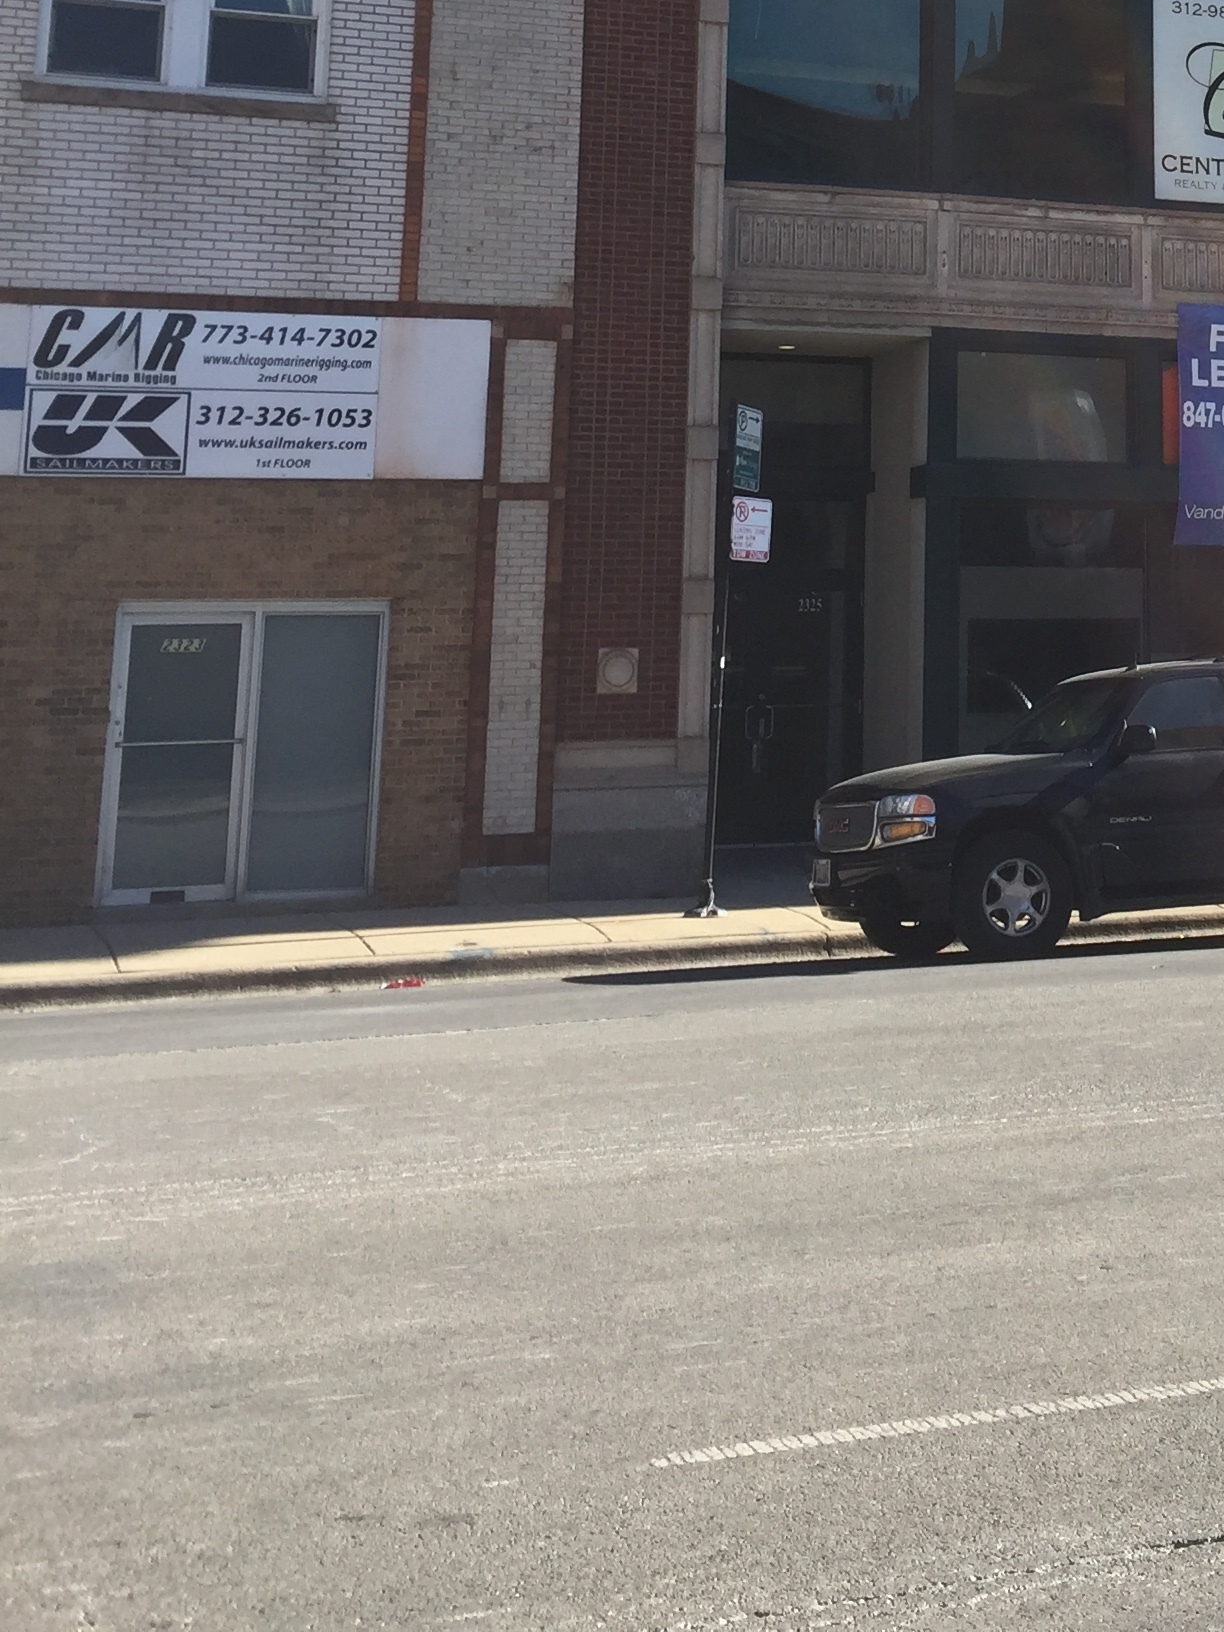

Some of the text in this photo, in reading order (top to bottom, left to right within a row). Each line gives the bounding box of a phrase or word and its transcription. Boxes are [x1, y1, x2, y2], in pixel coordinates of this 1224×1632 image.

[1174, 179, 1218, 192] REALTY
[33, 309, 196, 371] CMR
[201, 324, 377, 349] 773-414-7302
[203, 353, 372, 371] www.chicagomarinerigging.com
[35, 370, 177, 385] Chicago Marine Rigging
[257, 373, 318, 384] 2nd FLOOR
[195, 405, 373, 428] 312-326-1053
[32, 394, 181, 458] UK
[198, 436, 368, 450] www.uksailmakers.com
[36, 458, 174, 470] SAILMAKERS
[256, 458, 311, 468] 1st FLOOR
[798, 598, 823, 612] 2325
